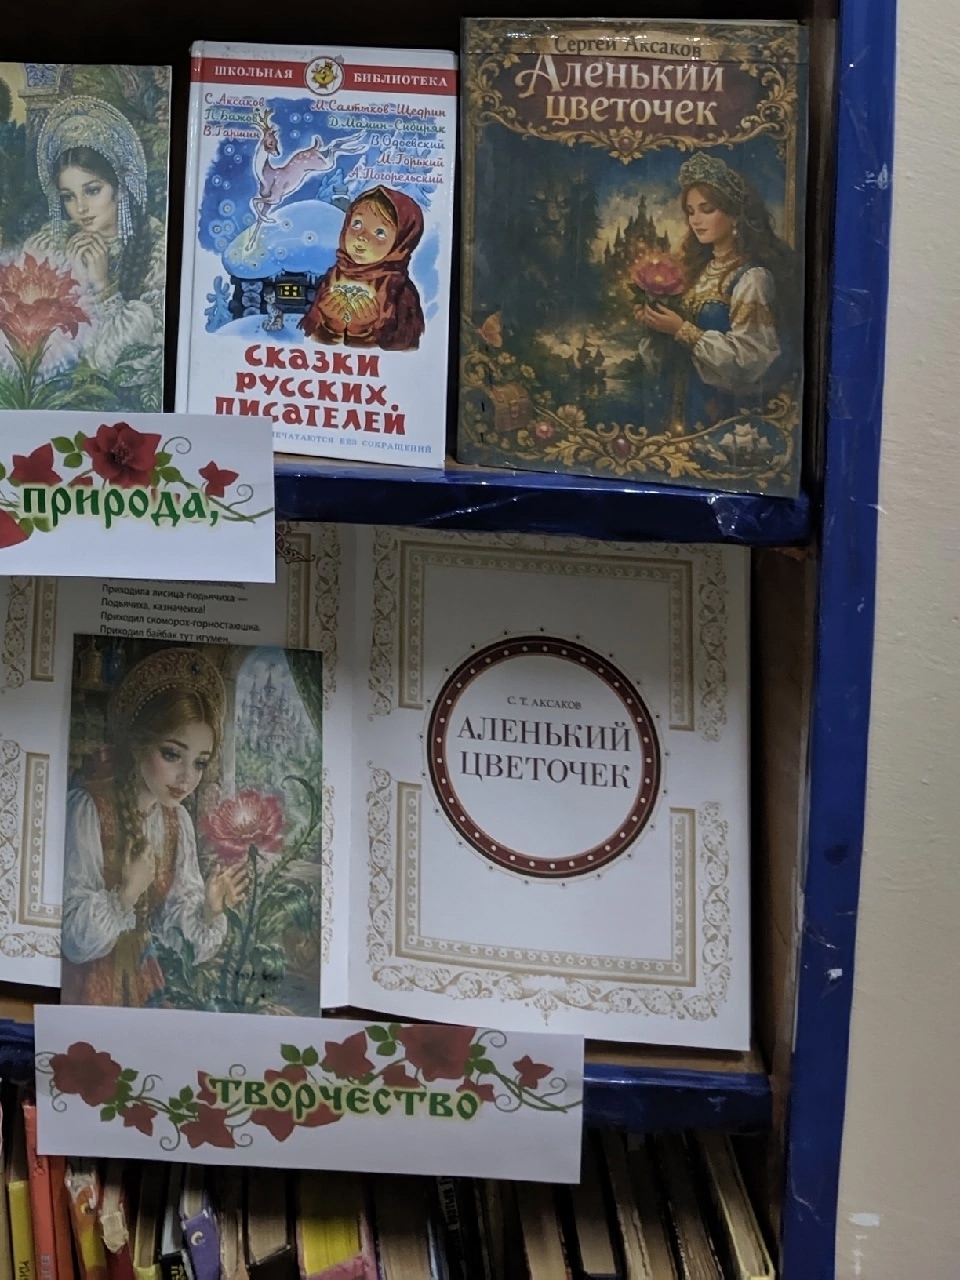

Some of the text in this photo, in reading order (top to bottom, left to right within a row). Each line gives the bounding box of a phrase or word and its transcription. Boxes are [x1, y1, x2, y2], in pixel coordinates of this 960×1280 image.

[214, 65, 448, 88] ШКОЛЬНАЯ БИБЛИОТЕКА
[514, 54, 725, 99] Аленький
[545, 94, 719, 126] цветочек
[23, 486, 219, 527] природа,
[102, 584, 150, 597] Приходила
[100, 611, 144, 624] Приходил
[507, 696, 582, 711] С. Т. АКСАКОВ
[457, 716, 632, 752] АЛЕНЬКИЙ
[460, 751, 632, 789] ЦВЕТОЧЕК
